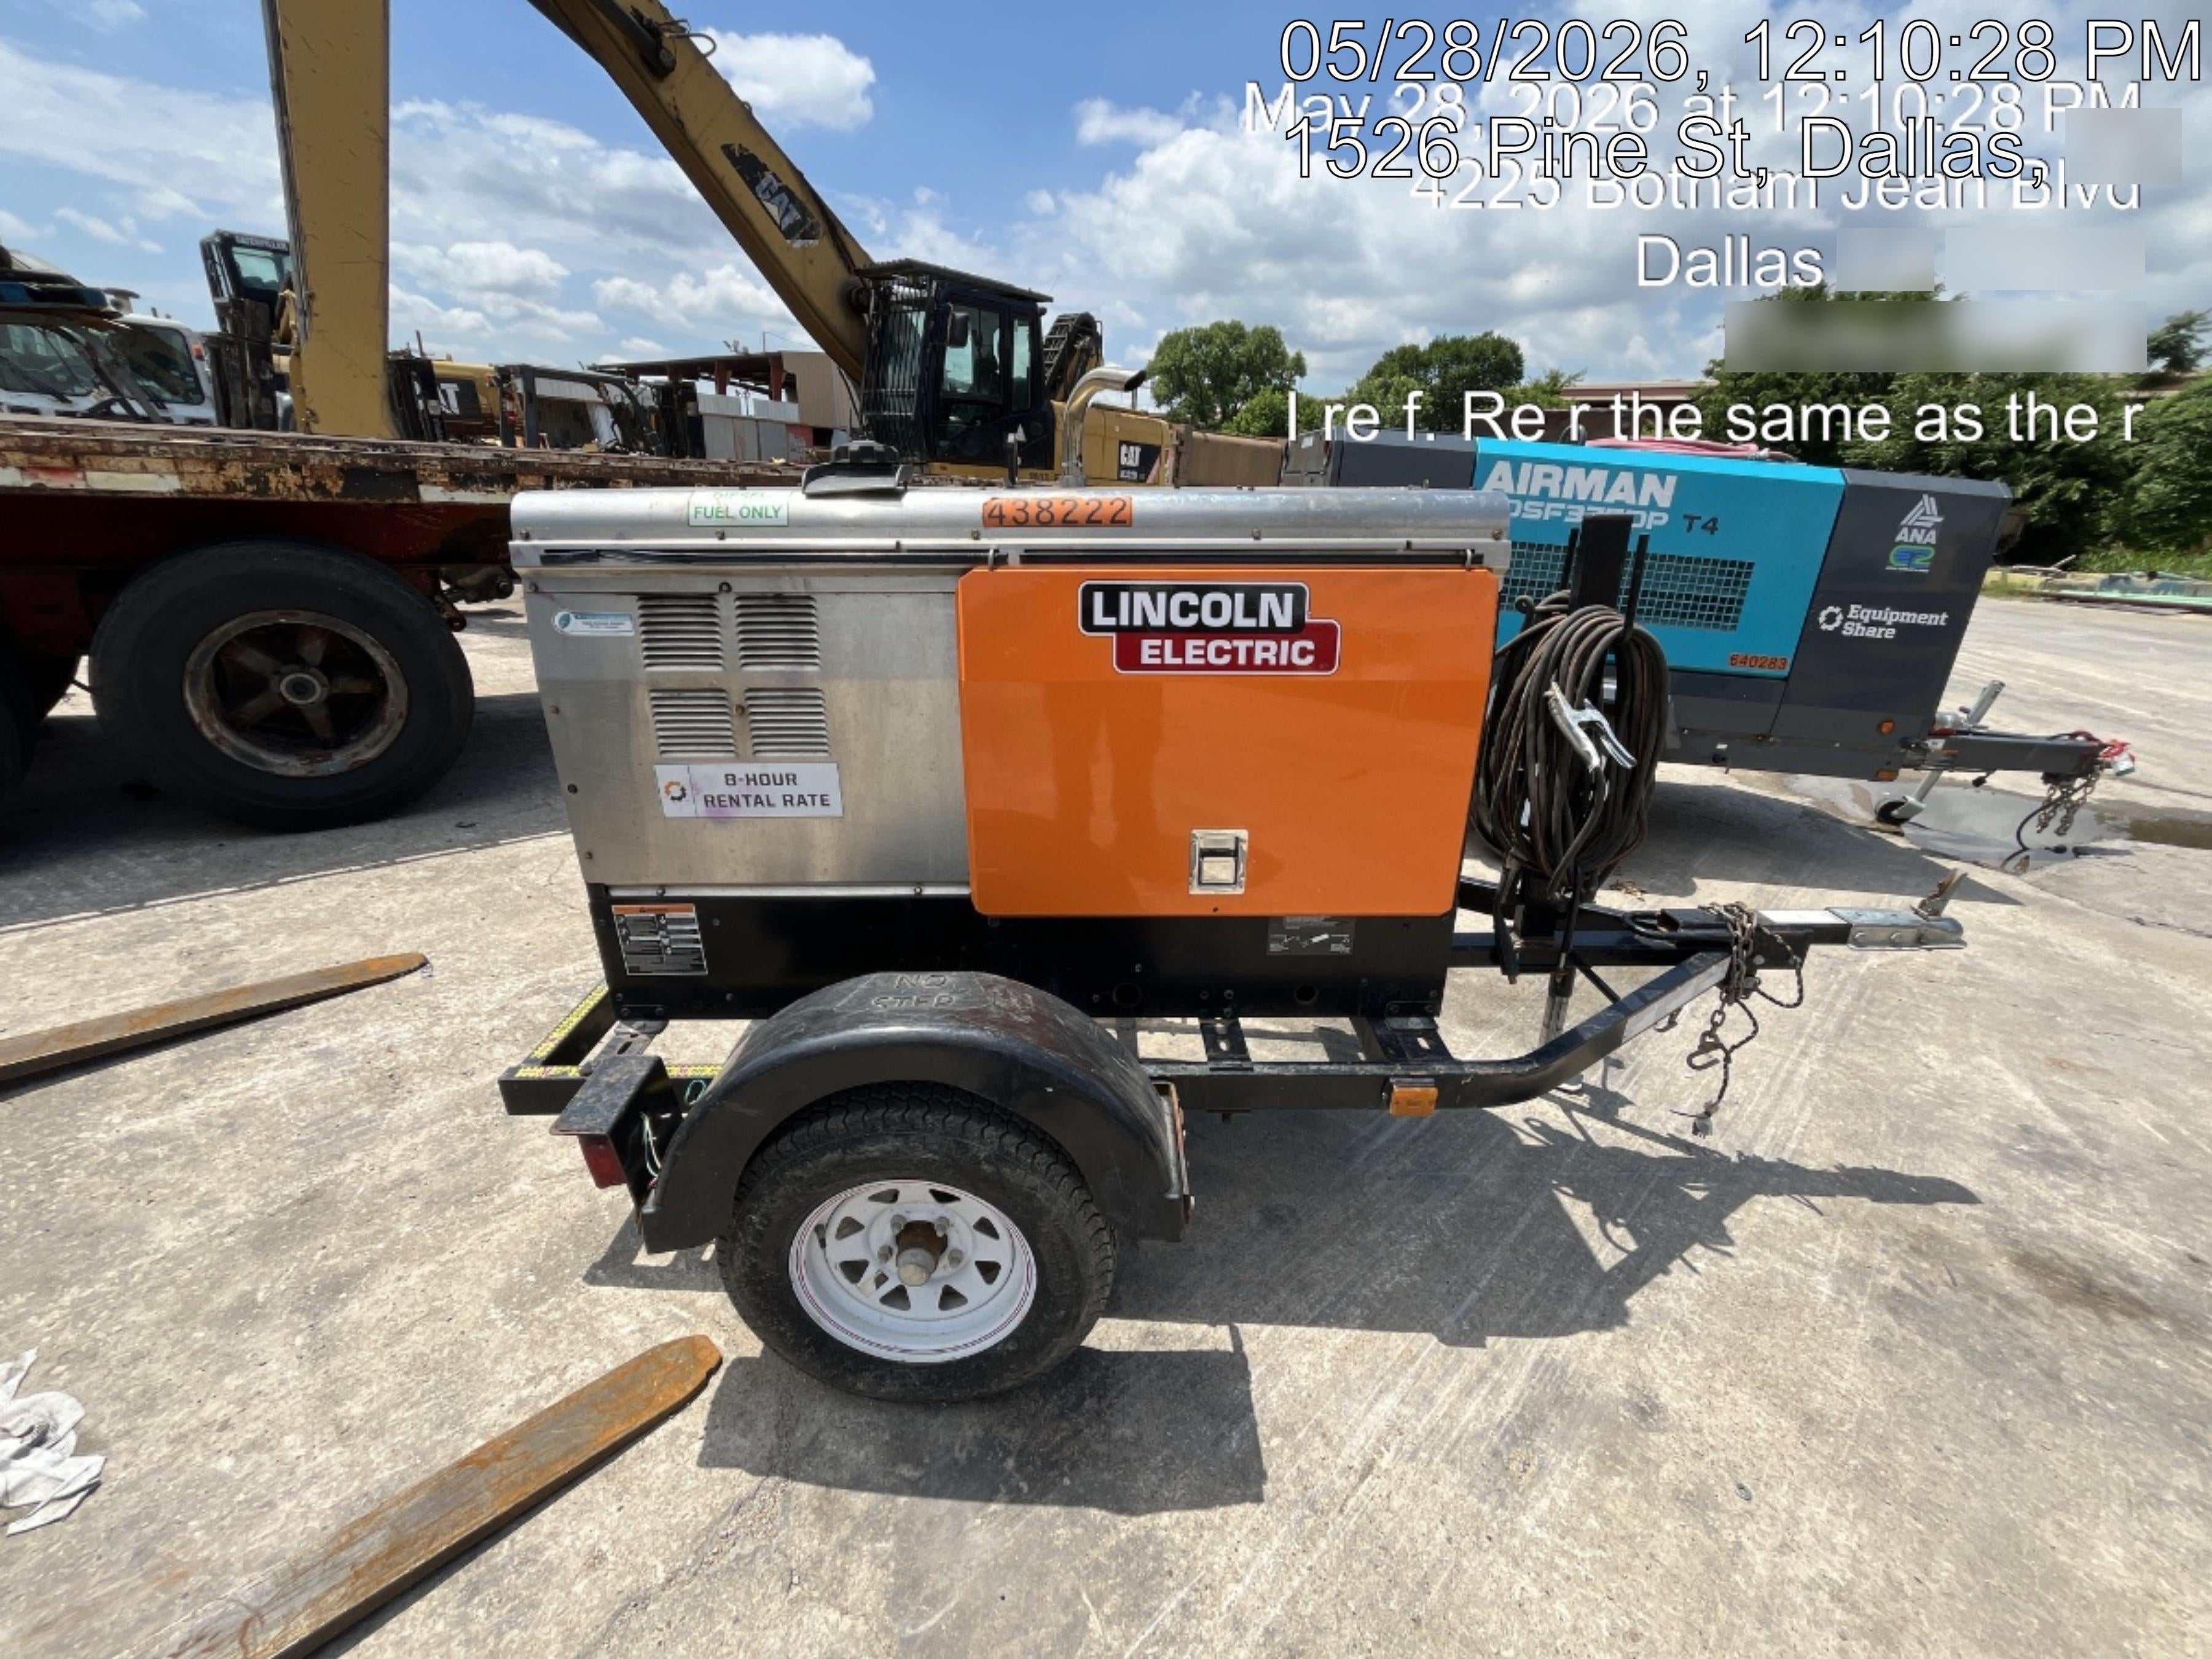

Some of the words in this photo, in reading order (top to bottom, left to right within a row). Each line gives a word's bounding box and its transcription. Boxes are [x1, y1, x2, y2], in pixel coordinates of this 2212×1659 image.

[1120, 442, 1142, 468] CAT
[1481, 460, 1678, 508] AIRMAN
[694, 505, 734, 519] FUEL
[739, 504, 782, 519] ONLY
[987, 497, 1128, 527] 438222
[1683, 514, 1720, 535] T4
[1894, 526, 1936, 544] ANA
[1092, 591, 1293, 627] LINCOLN
[1846, 604, 1949, 626] Equipment
[1841, 621, 1896, 639] Share
[1140, 638, 1315, 665] ELECTRIC
[724, 773, 798, 786] 8-HOUR
[704, 793, 776, 808] RENTAL
[782, 793, 831, 807] RATE
